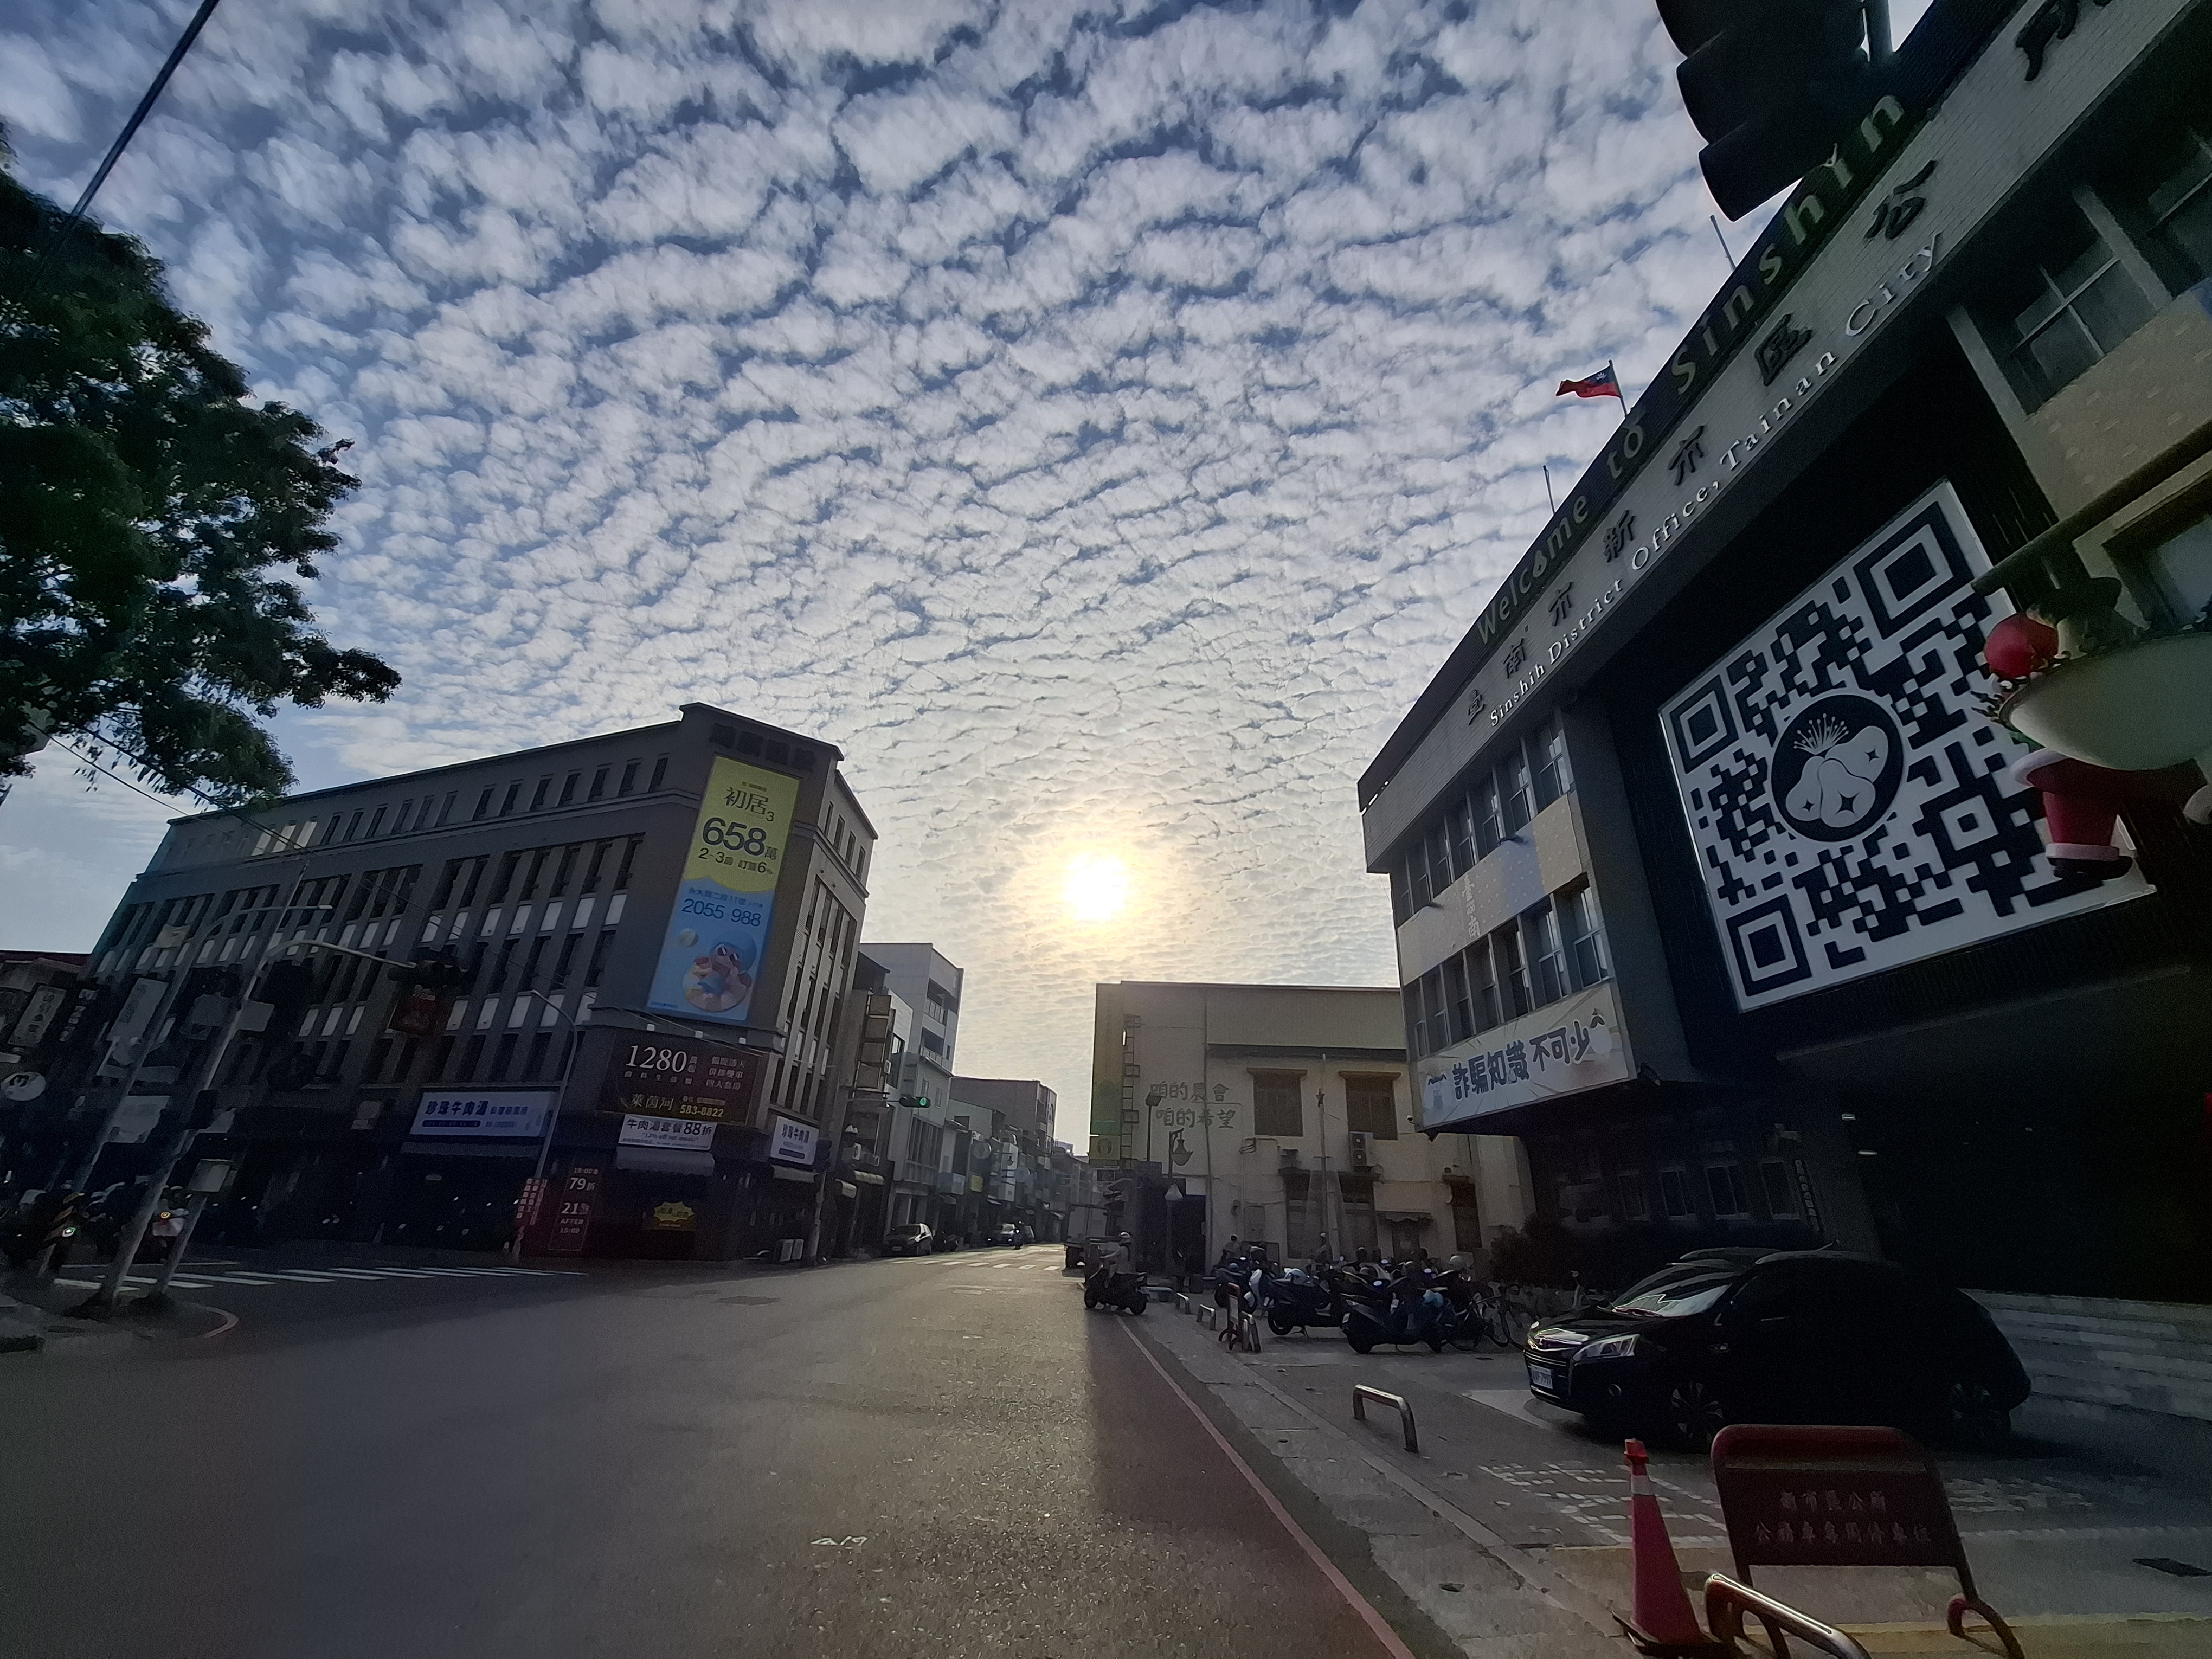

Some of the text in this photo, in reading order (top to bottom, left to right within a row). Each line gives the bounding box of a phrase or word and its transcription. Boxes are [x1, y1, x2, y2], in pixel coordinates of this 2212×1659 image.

[1475, 494, 1588, 645] Welcome
[1606, 422, 1645, 480] to
[1489, 233, 1942, 727] Sinshih District Office, Tainan City
[681, 898, 761, 927] 2055 988
[625, 1045, 688, 1073] 1280
